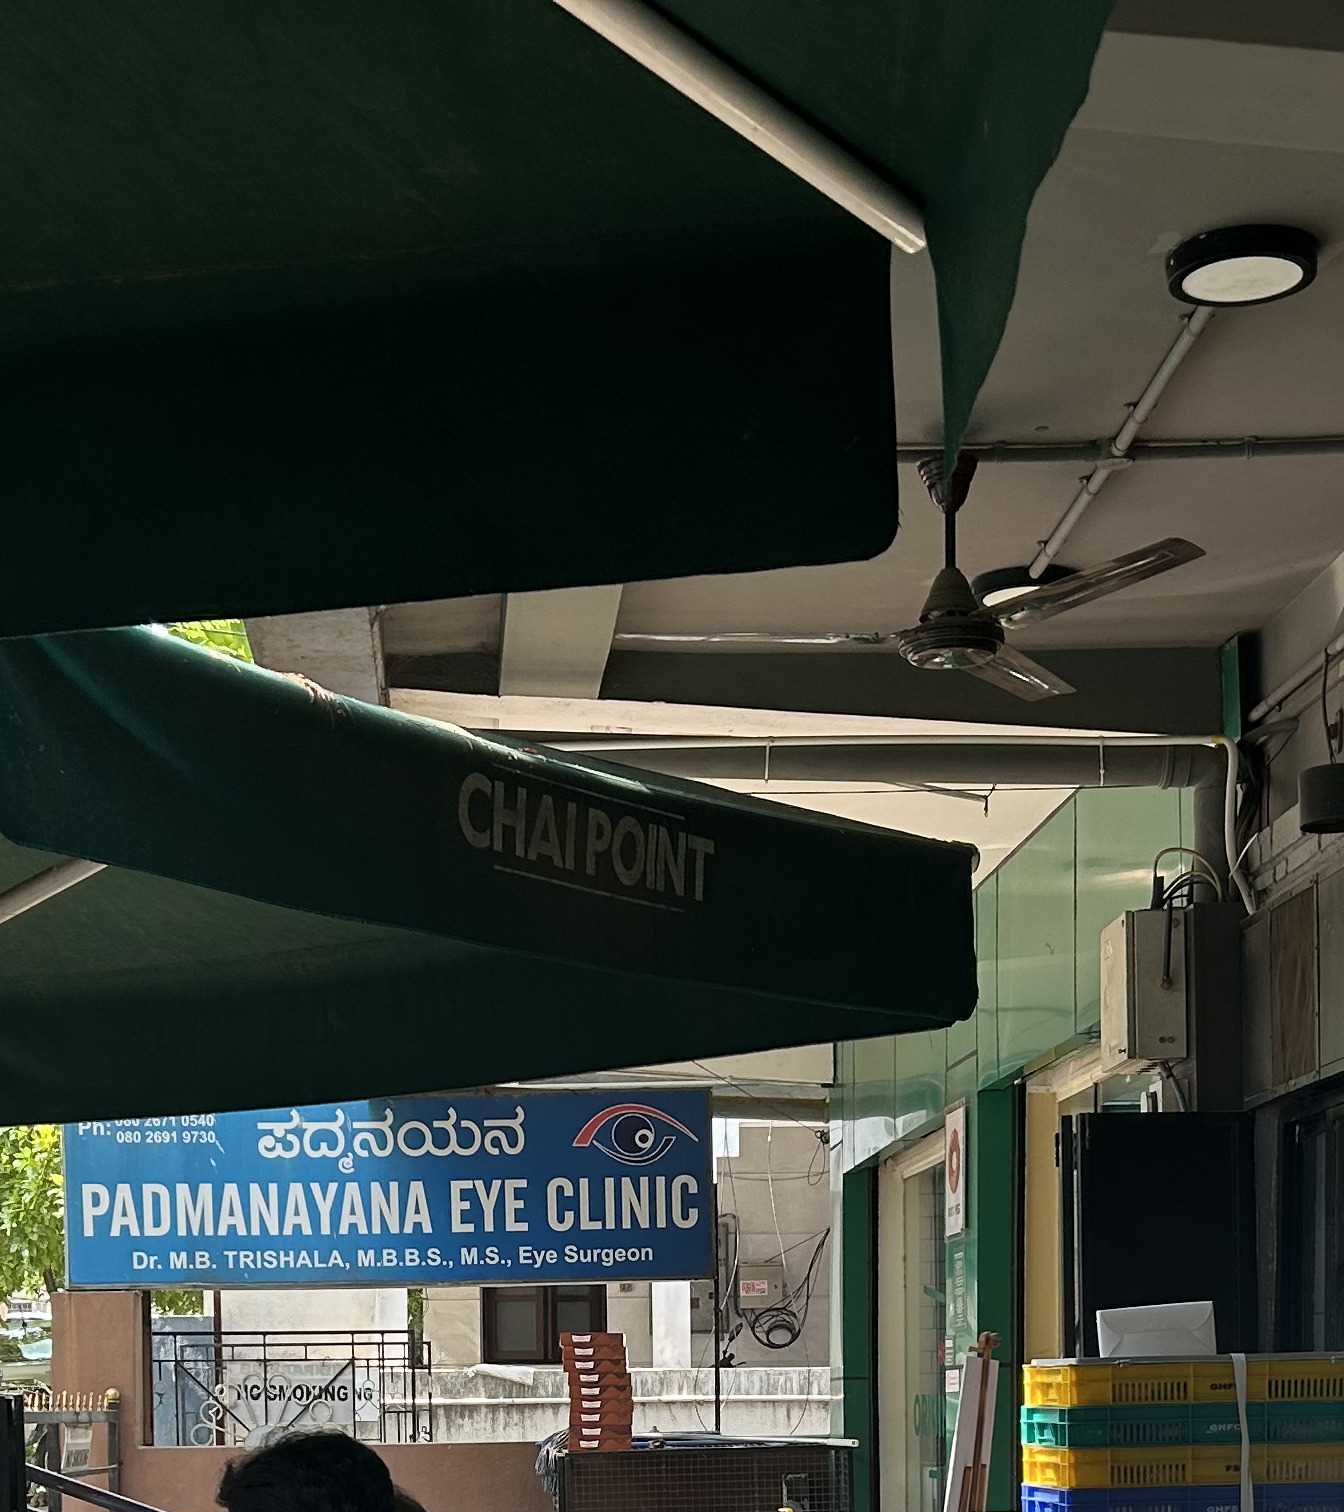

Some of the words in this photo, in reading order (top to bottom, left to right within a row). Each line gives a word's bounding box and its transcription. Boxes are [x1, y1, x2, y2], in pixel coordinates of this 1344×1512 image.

[458, 772, 577, 871] CHAI
[585, 807, 715, 902] POINT
[181, 1114, 215, 1127] 0540
[116, 1131, 141, 1144] 080
[146, 1131, 177, 1144] 2691
[182, 1131, 216, 1144] 9730
[256, 1106, 525, 1174] ಪದ್ಮನಯನ
[81, 1181, 432, 1237] PADMANAYANA
[450, 1179, 529, 1233] EYE
[547, 1174, 698, 1232] CLINIC
[132, 1252, 162, 1270] Dr.
[169, 1251, 216, 1269] M.B.
[224, 1249, 350, 1270] TRISHALA,
[357, 1247, 454, 1269] M.B.B.S.,
[460, 1246, 512, 1268] M.S.,
[519, 1246, 557, 1269] Eye
[564, 1244, 654, 1267] Surgeon
[265, 1384, 349, 1402] SMOKING
